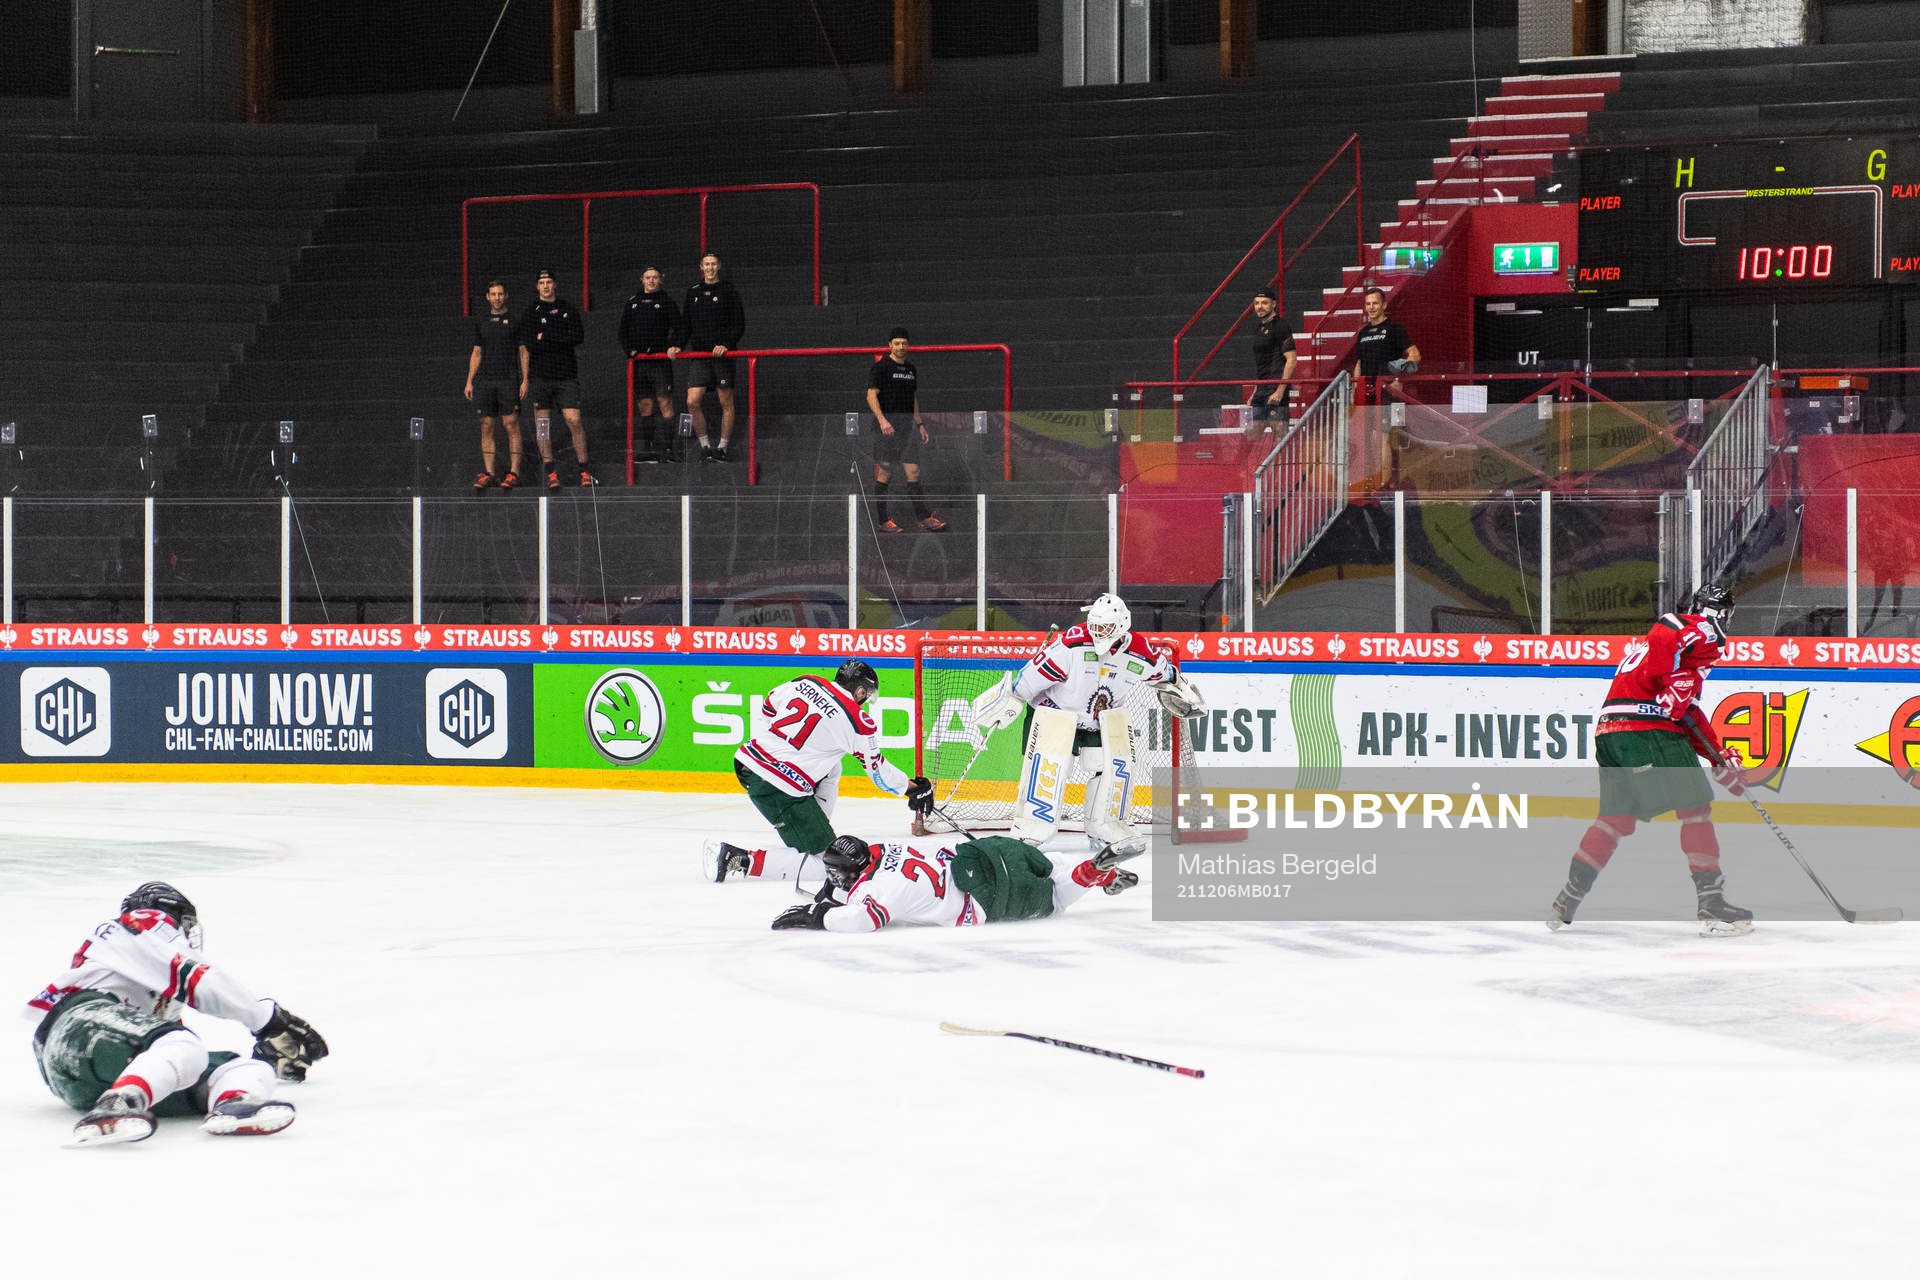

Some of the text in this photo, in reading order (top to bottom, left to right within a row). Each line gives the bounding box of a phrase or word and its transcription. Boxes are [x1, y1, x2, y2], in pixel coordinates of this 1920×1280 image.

[1675, 157, 1695, 188] H
[1867, 149, 1887, 181] G
[1746, 187, 1815, 198] WESTERSTRAND
[1891, 183, 1920, 199] PLAY
[1580, 196, 1622, 211] PLAYER
[1739, 245, 1833, 280] 10:00
[1890, 257, 1920, 272] PLAY
[1579, 267, 1621, 281] PLAYER
[1518, 350, 1540, 366] UT
[31, 627, 129, 646] STRAUSS
[172, 627, 268, 646] STRAUSS
[310, 628, 402, 646] STRAUSS
[443, 628, 532, 647] STRAUSS
[570, 629, 654, 648] STRAUSS
[692, 630, 778, 650] STRAUSS
[817, 633, 907, 653] STRAUSS
[1217, 636, 1315, 656] STRAUSS
[1359, 637, 1460, 658] STRAUSS
[1506, 639, 1610, 660] STRAUSS
[165, 672, 373, 726] JOIN NOW!
[795, 681, 839, 719] SERNEKE
[40, 686, 92, 738] CHL
[443, 687, 491, 740] CHL
[691, 681, 988, 752] ŠDA
[769, 697, 823, 751] 21
[165, 728, 373, 752] CHL-FAN-CHALLENGE.COM
[1358, 711, 1592, 760] APK-INVEST
